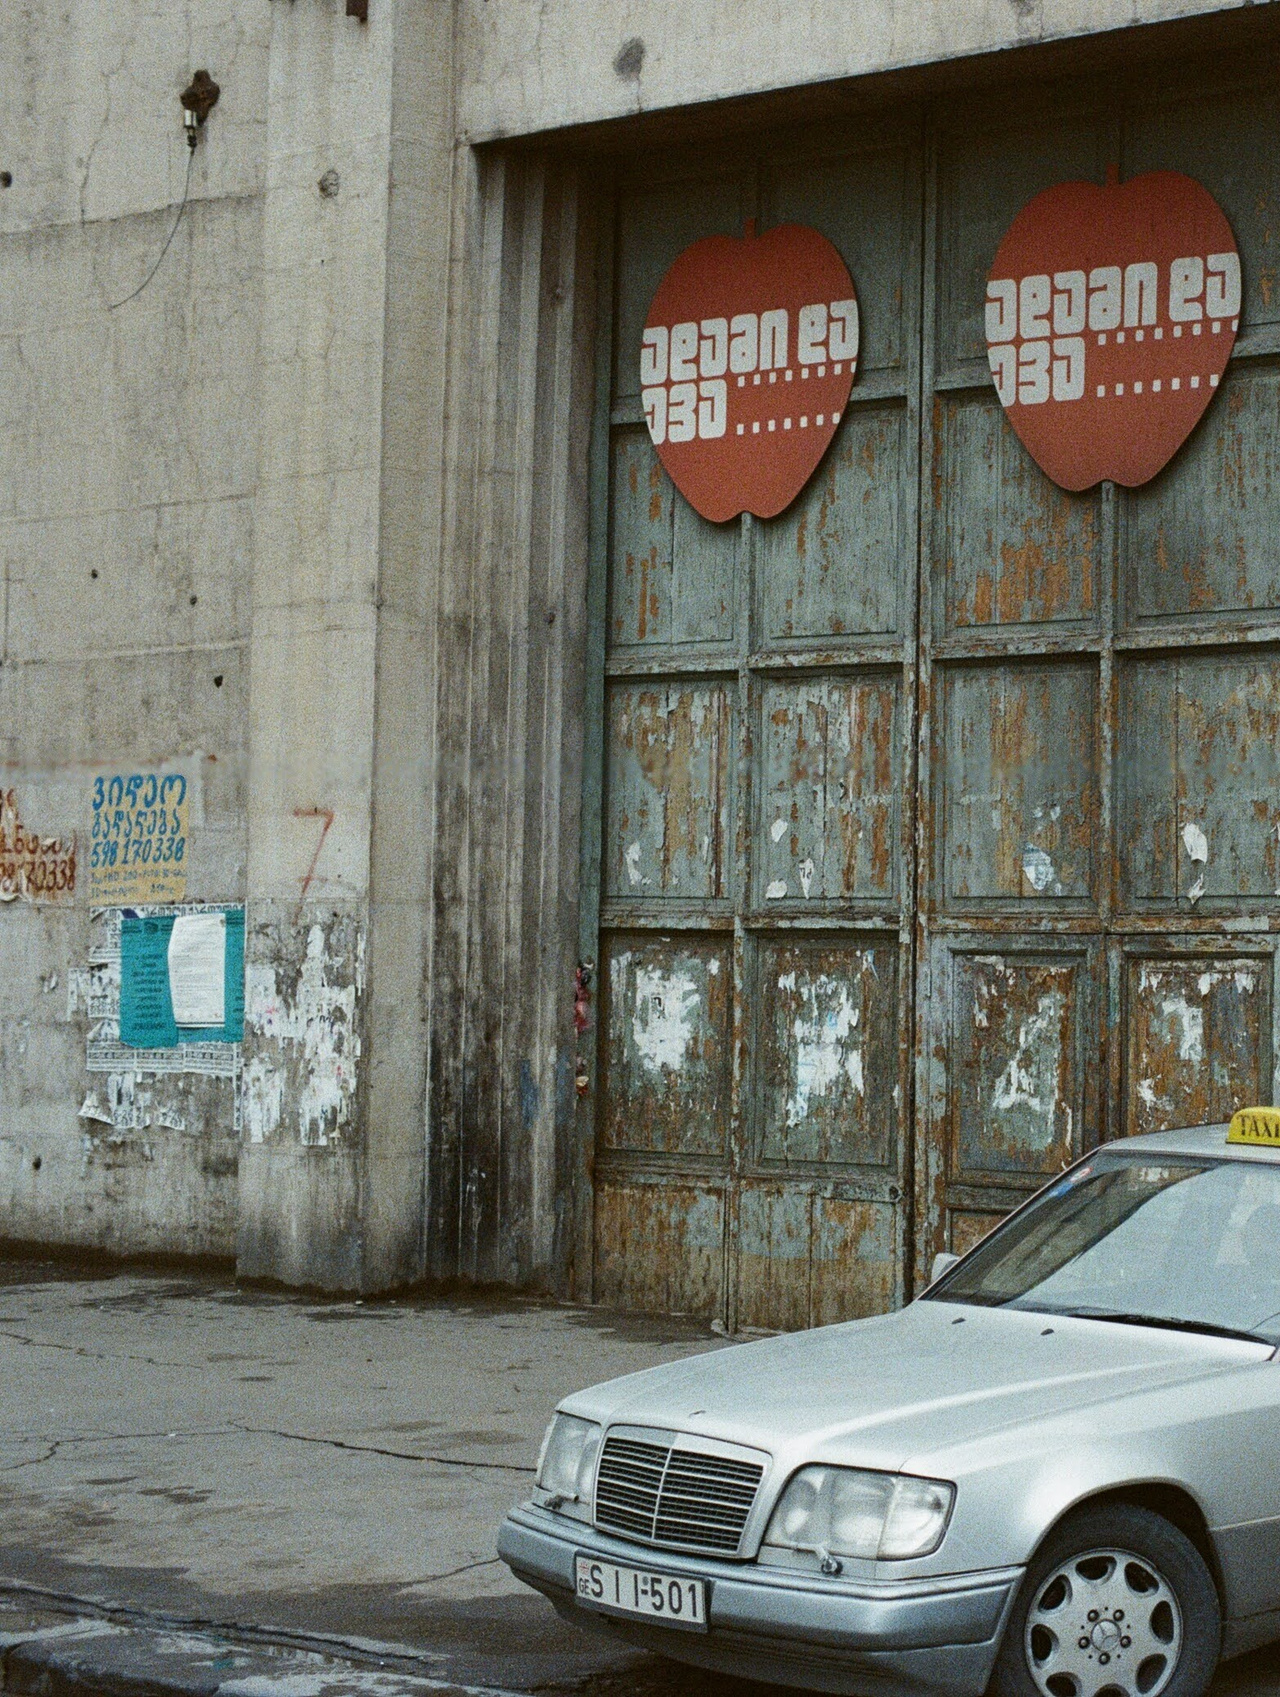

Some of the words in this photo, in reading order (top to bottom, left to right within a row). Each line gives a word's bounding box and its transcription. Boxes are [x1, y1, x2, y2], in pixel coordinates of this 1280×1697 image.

[1169, 253, 1241, 321] და
[798, 301, 858, 365] და
[1236, 1115, 1280, 1138] TAXI
[578, 1577, 590, 1595] GE
